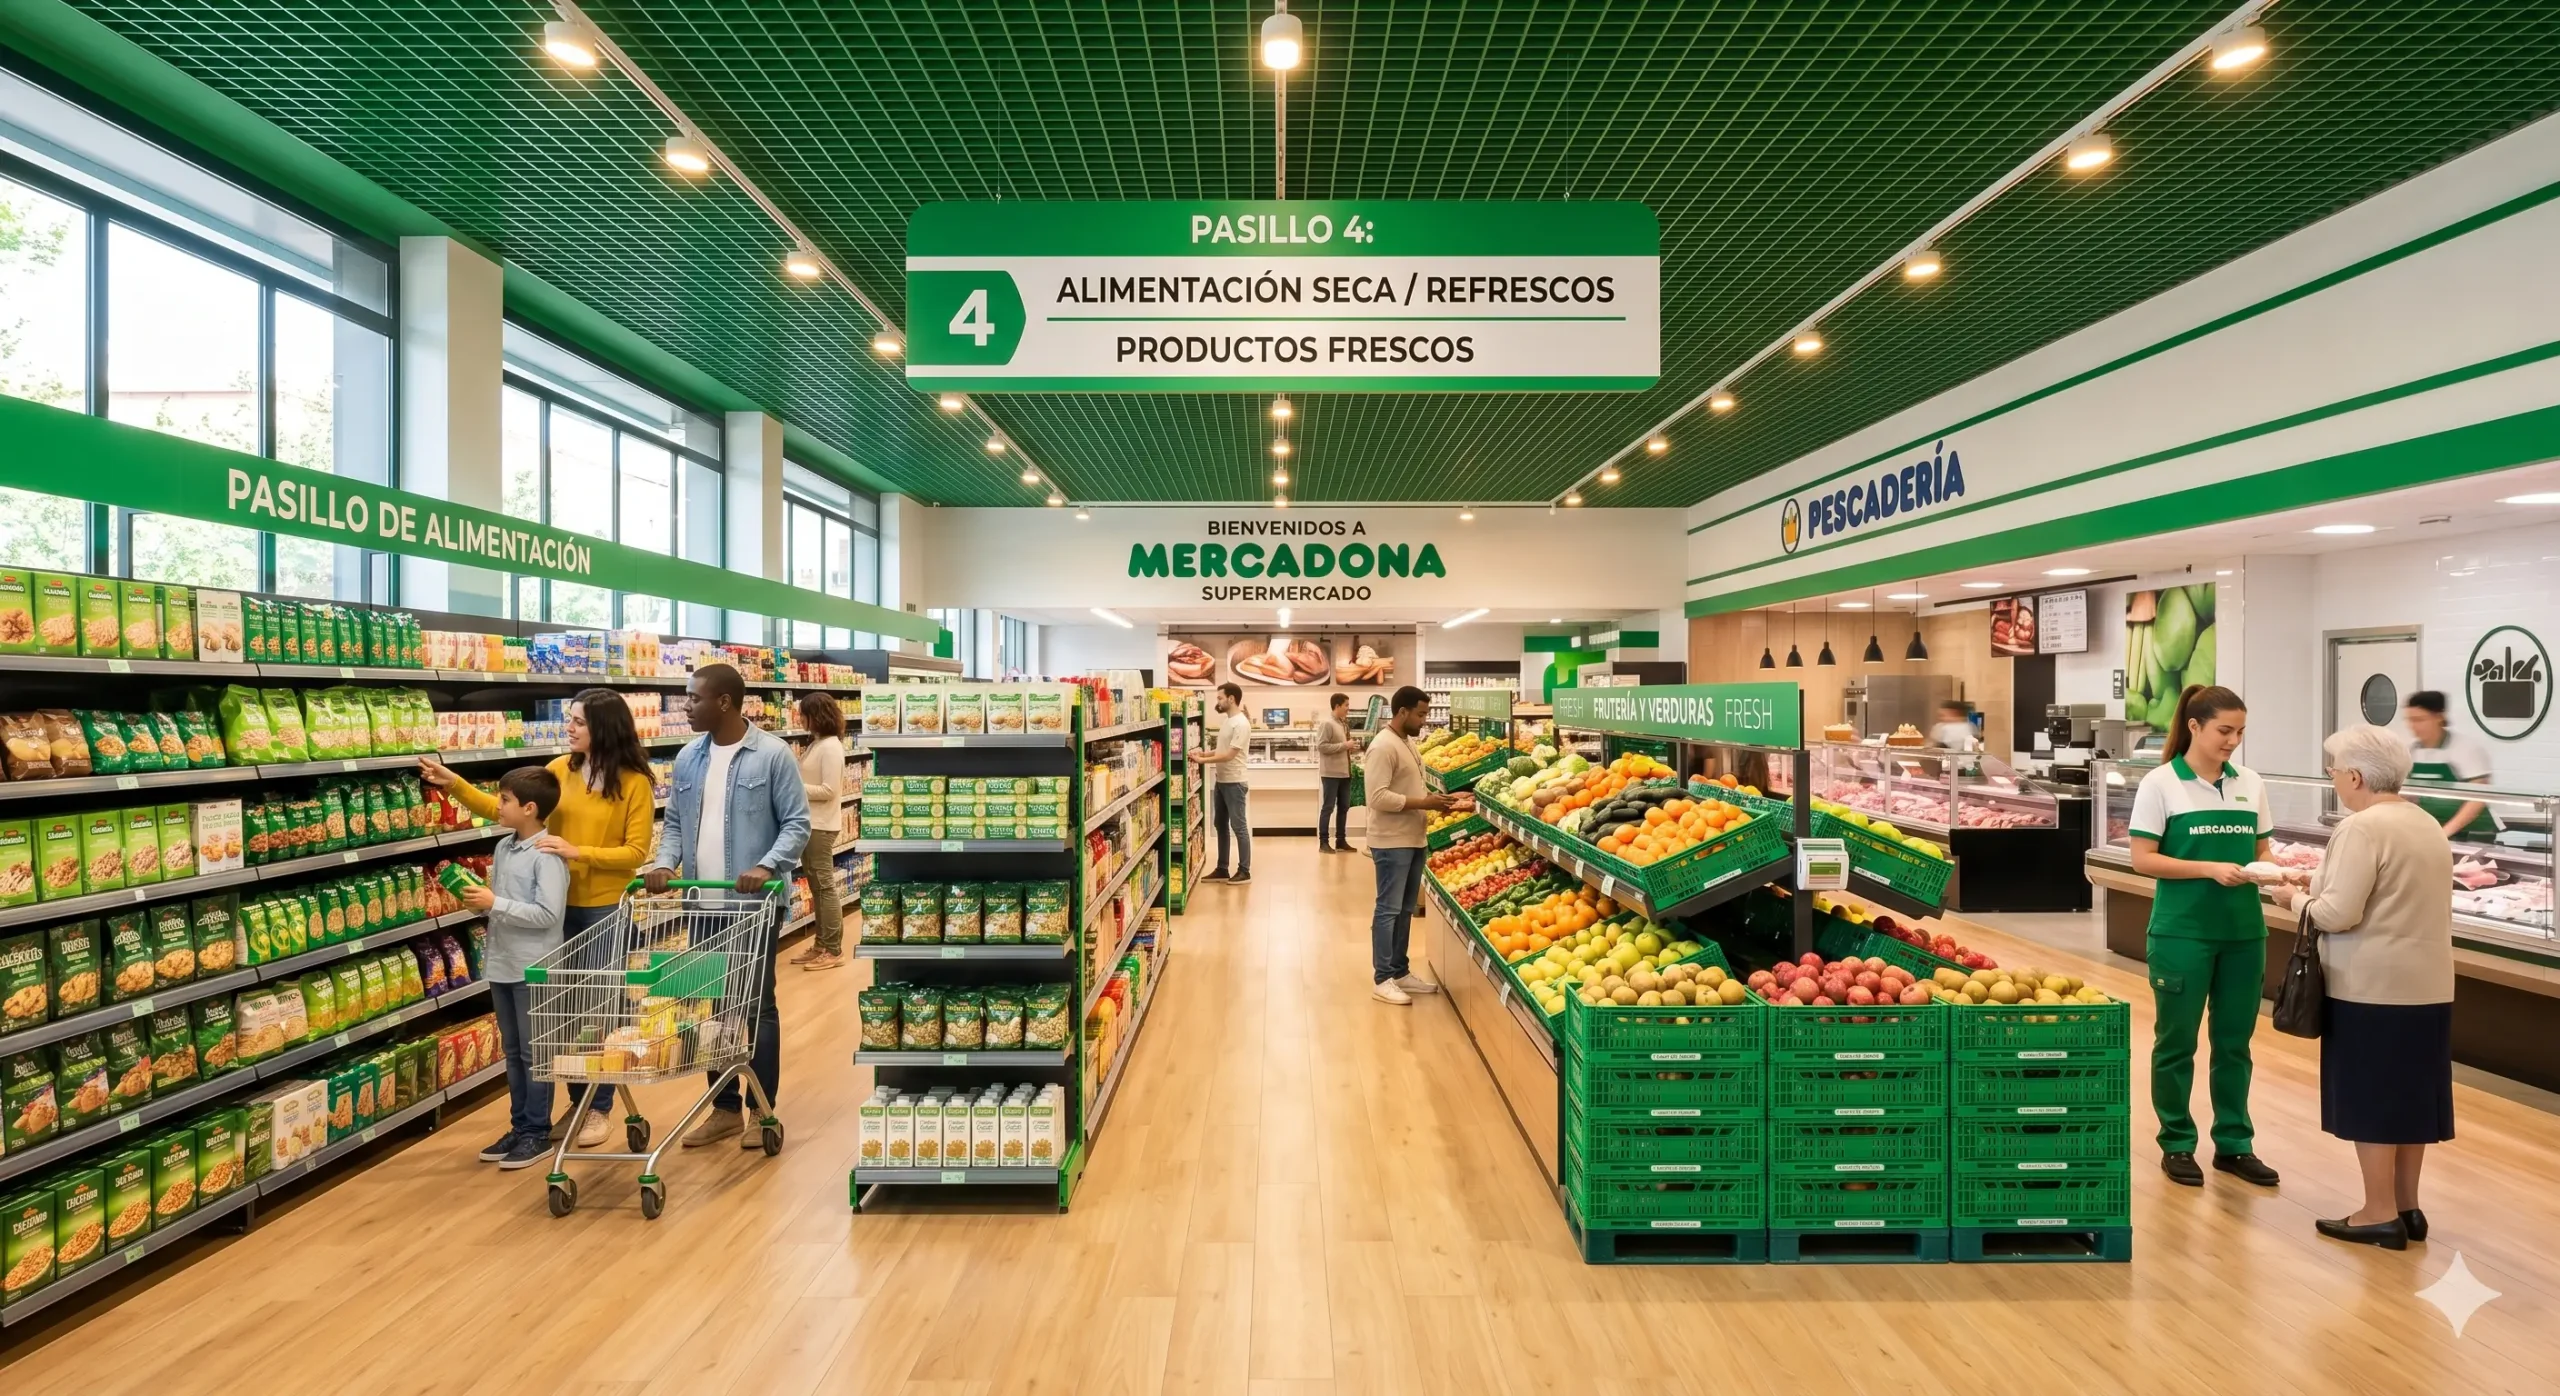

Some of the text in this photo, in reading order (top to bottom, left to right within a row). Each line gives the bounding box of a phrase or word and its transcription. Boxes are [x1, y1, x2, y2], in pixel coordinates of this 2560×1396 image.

[1192, 214, 1375, 244] PASILLO 4:
[1056, 269, 1615, 306] ALIMENTACIÓN SECA / REFRESCOS
[949, 289, 995, 346] 4
[1117, 336, 1474, 363] PRODUCTOS FRESCOS
[1808, 438, 1965, 539] PESCADERÍA
[227, 468, 592, 576] PASILLO DE ALIMENTACIÓN
[1208, 520, 1367, 536] BIENVENIDOS A
[1127, 542, 1447, 579] MERCADONA
[1201, 585, 1372, 601] SUPERMERCADO
[1593, 690, 1637, 721] FRUTERÍA
[1639, 698, 1647, 721] Y
[1648, 697, 1714, 727] VERDURAS
[1725, 698, 1773, 730] FRESH
[2189, 825, 2254, 835] MERCADONA
